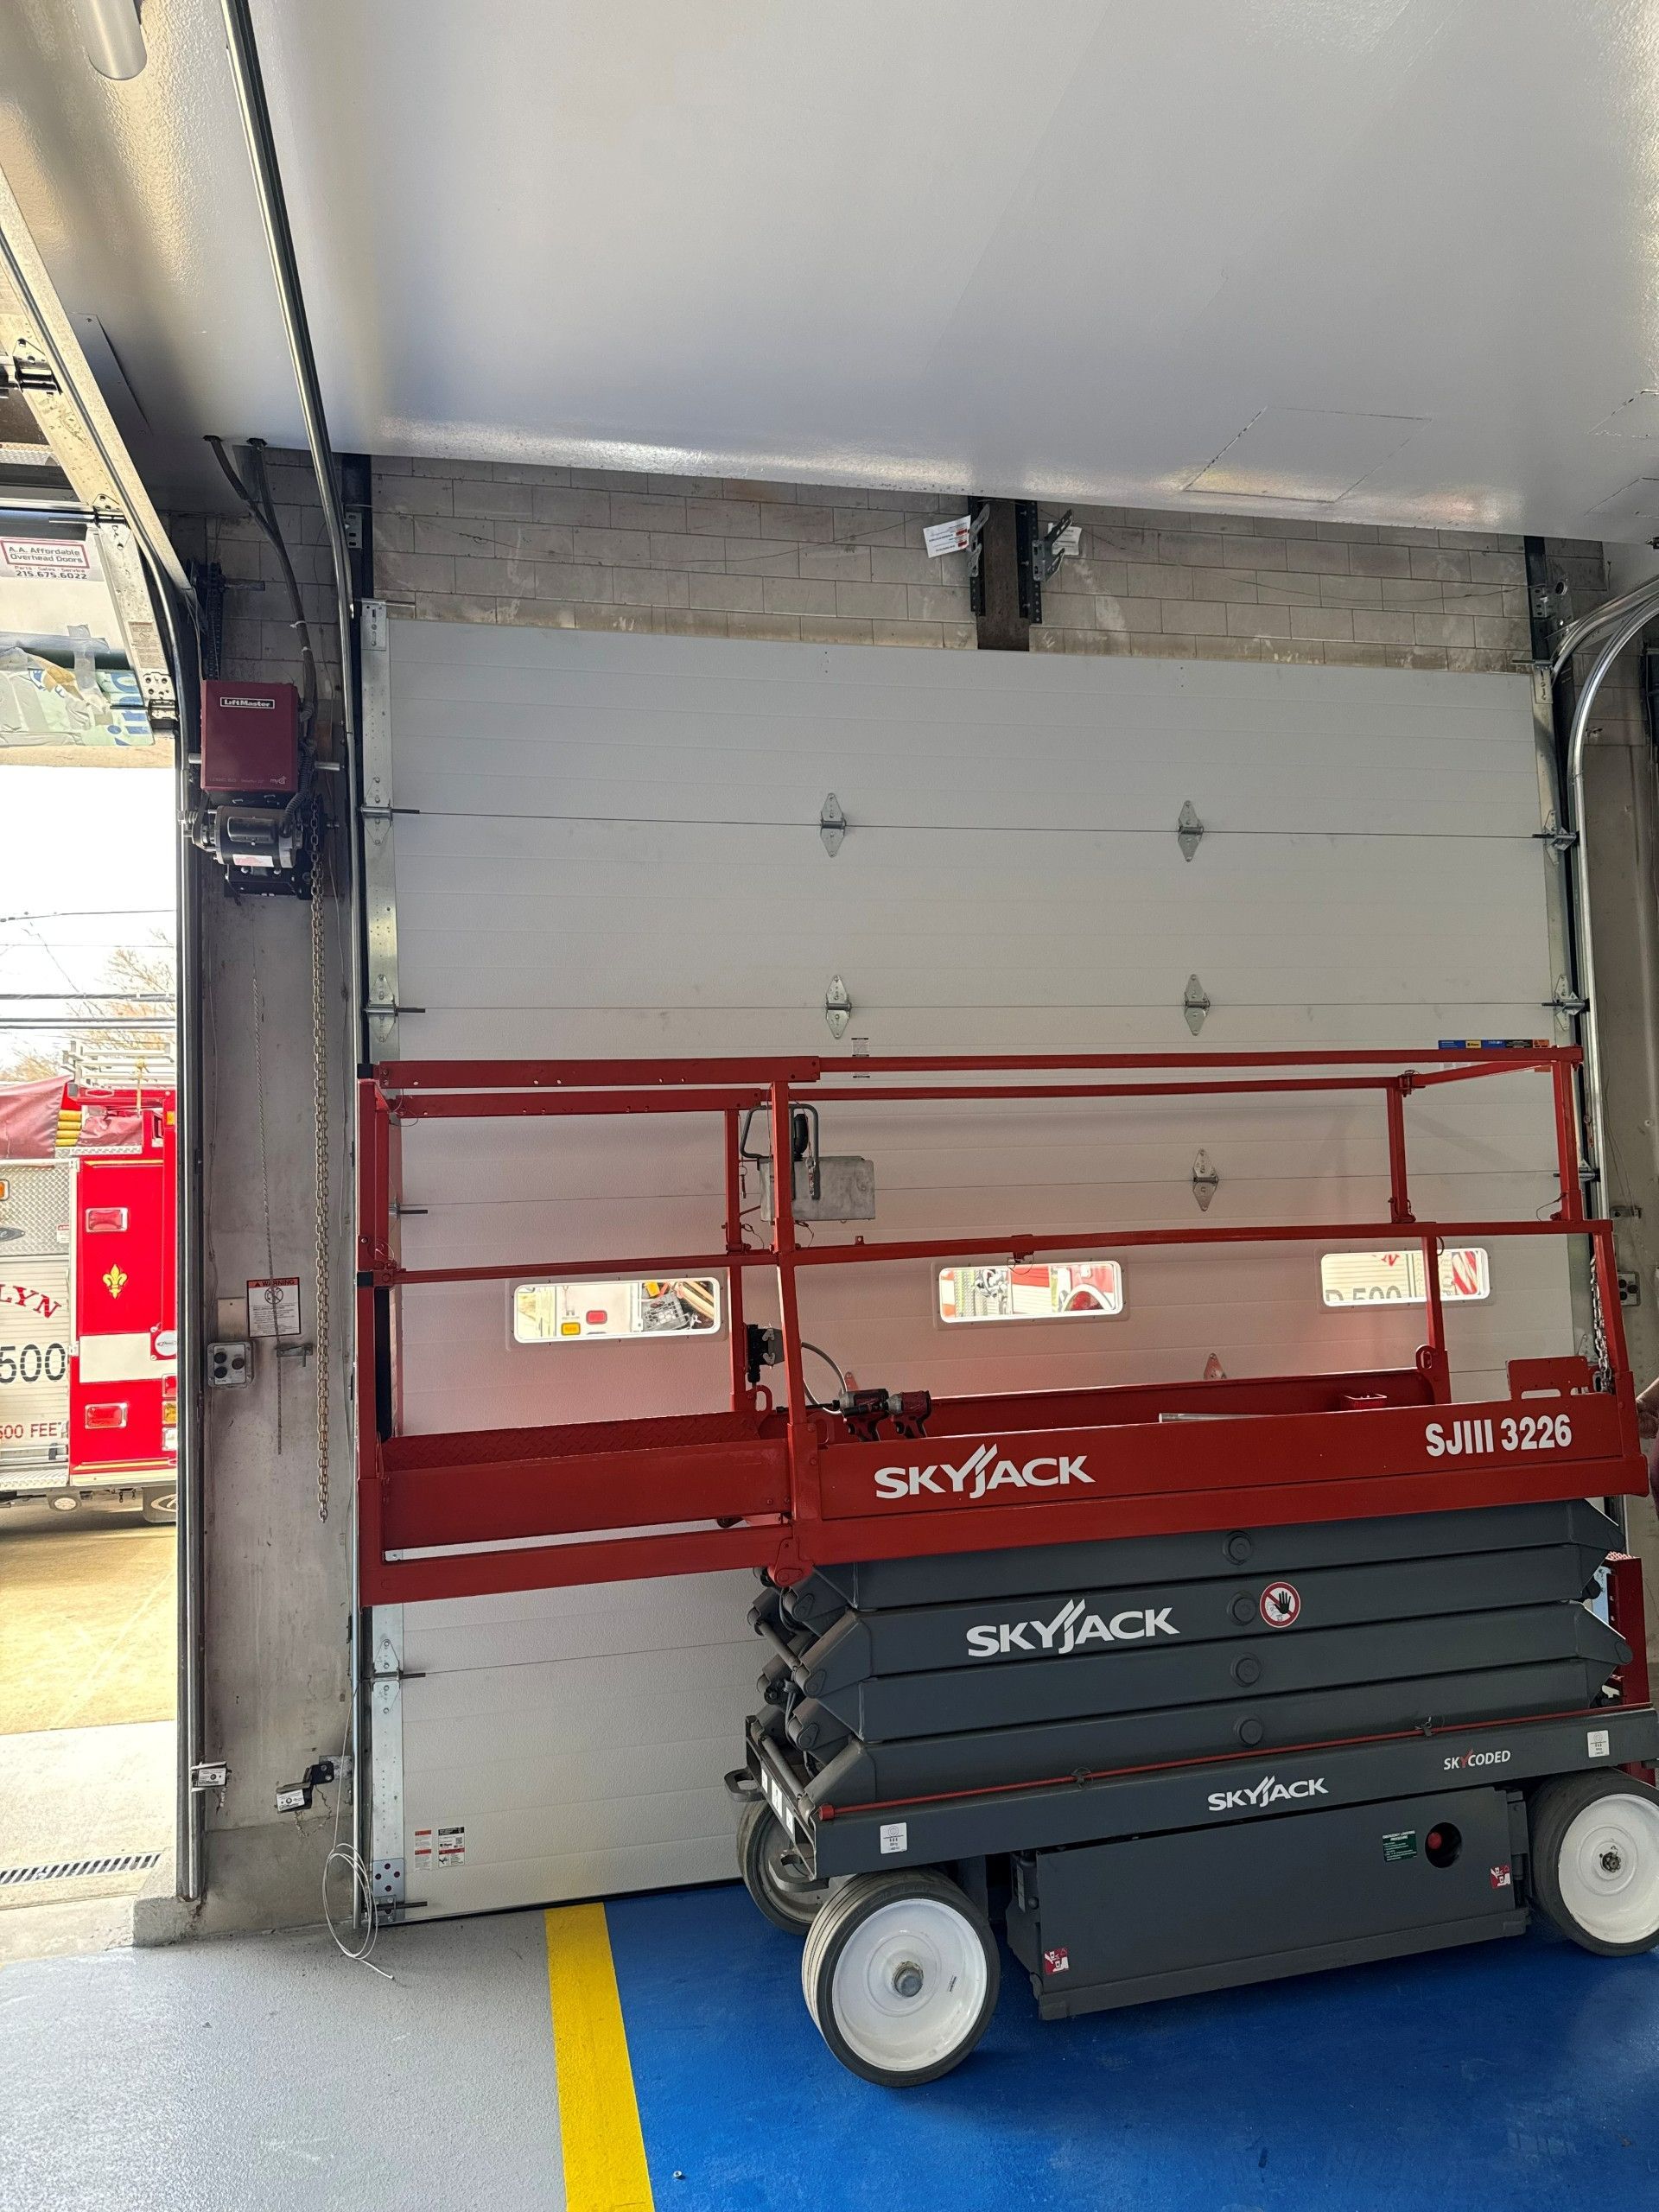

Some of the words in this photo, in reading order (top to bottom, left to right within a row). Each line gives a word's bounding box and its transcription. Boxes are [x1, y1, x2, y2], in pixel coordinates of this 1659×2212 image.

[10, 553, 54, 562] Overhead
[30, 547, 80, 556] Affordable
[16, 570, 87, 580] 215.675.6022
[1425, 1419, 1495, 1457] SJIII
[1500, 1414, 1573, 1452] 3226
[874, 1443, 1096, 1499] SKYJACK
[966, 1599, 1181, 1657] SKYJACK
[1443, 1748, 1511, 1770] SKYCODED
[1207, 1775, 1330, 1811] SKYJACK
